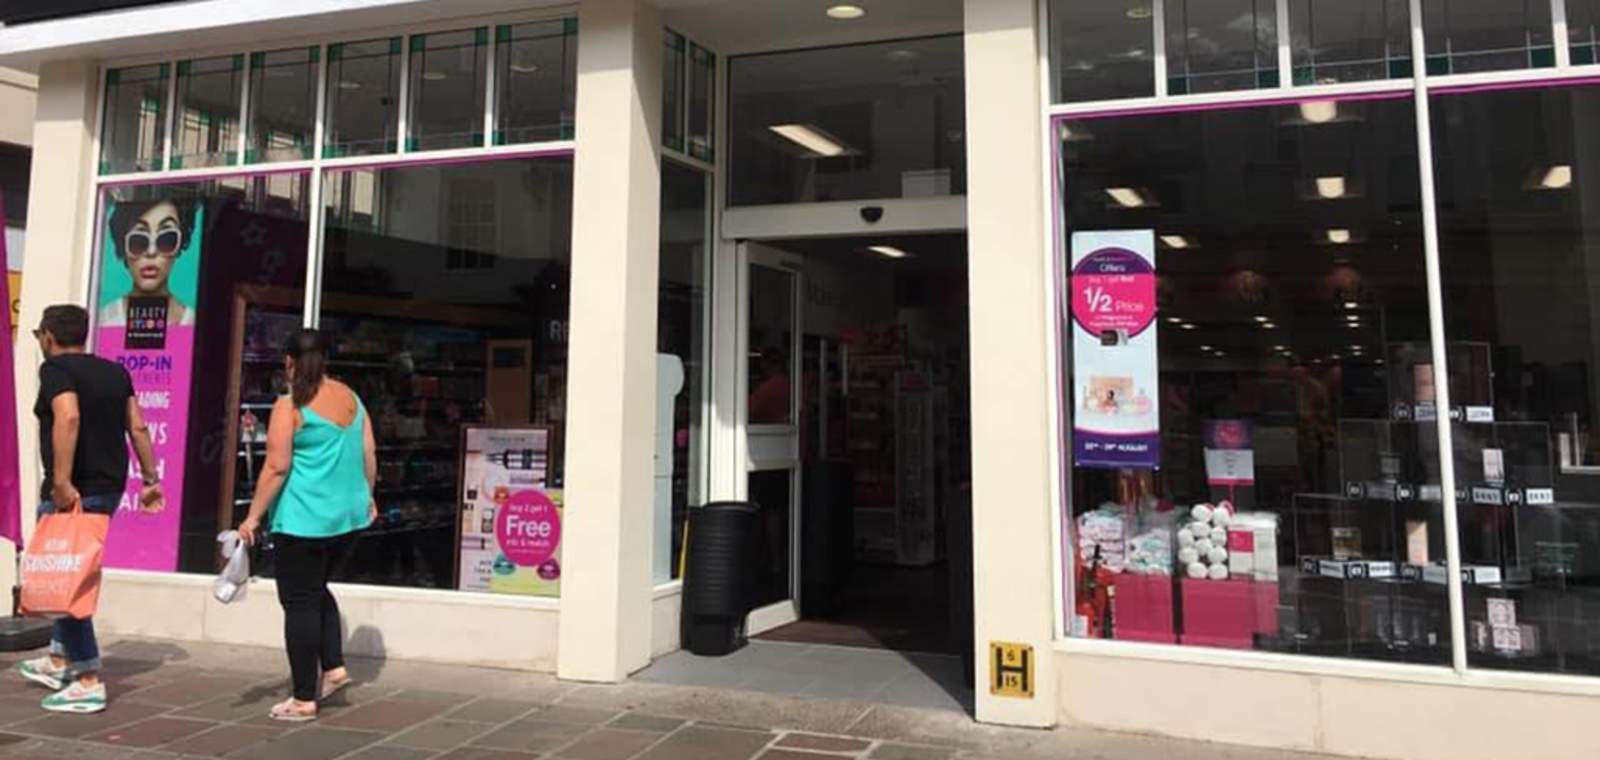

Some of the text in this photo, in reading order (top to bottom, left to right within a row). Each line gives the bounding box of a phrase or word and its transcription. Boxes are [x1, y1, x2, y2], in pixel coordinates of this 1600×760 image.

[506, 515, 552, 538] Free
[1007, 649, 1015, 662] 6
[996, 646, 1028, 692] H
[1005, 674, 1018, 688] 15
